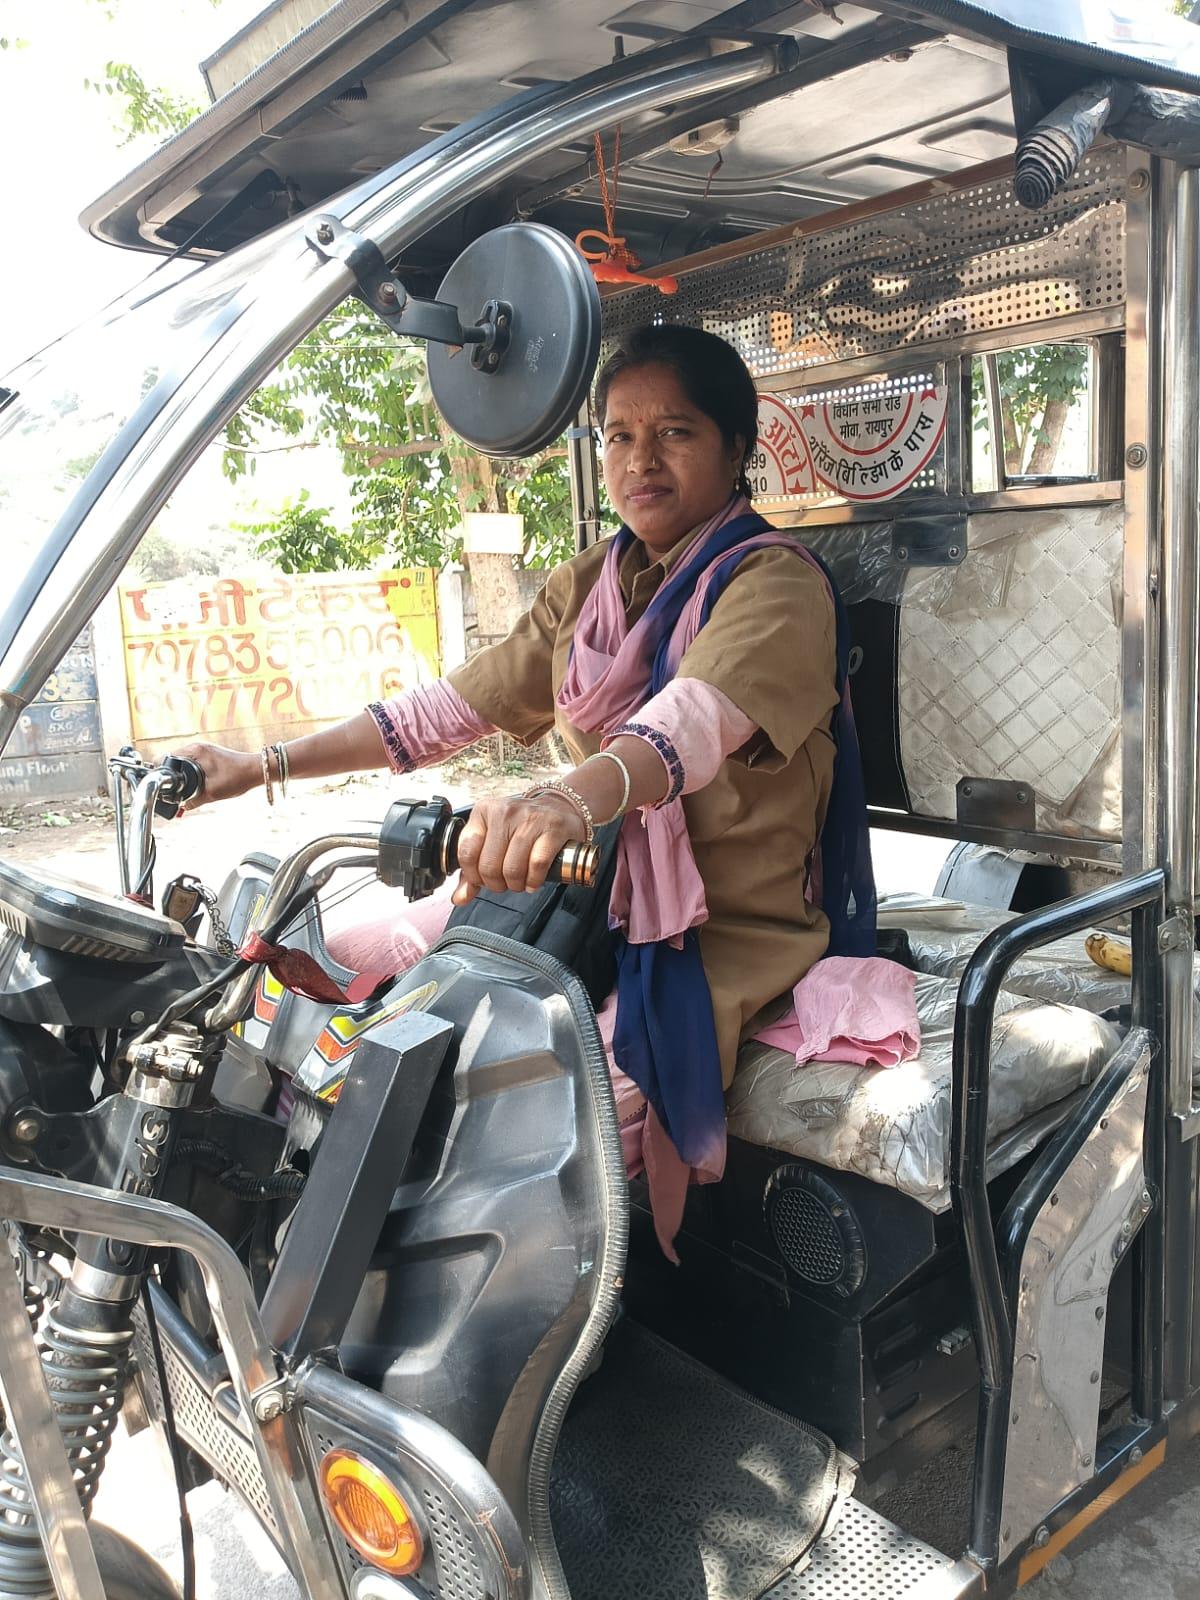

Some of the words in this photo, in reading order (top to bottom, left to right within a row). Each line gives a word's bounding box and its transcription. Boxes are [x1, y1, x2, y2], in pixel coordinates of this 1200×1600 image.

[861, 398, 882, 415] सभा
[765, 416, 808, 476] ऑटो
[864, 417, 894, 438] रायपुर
[887, 448, 904, 472] के
[903, 411, 935, 453] पास
